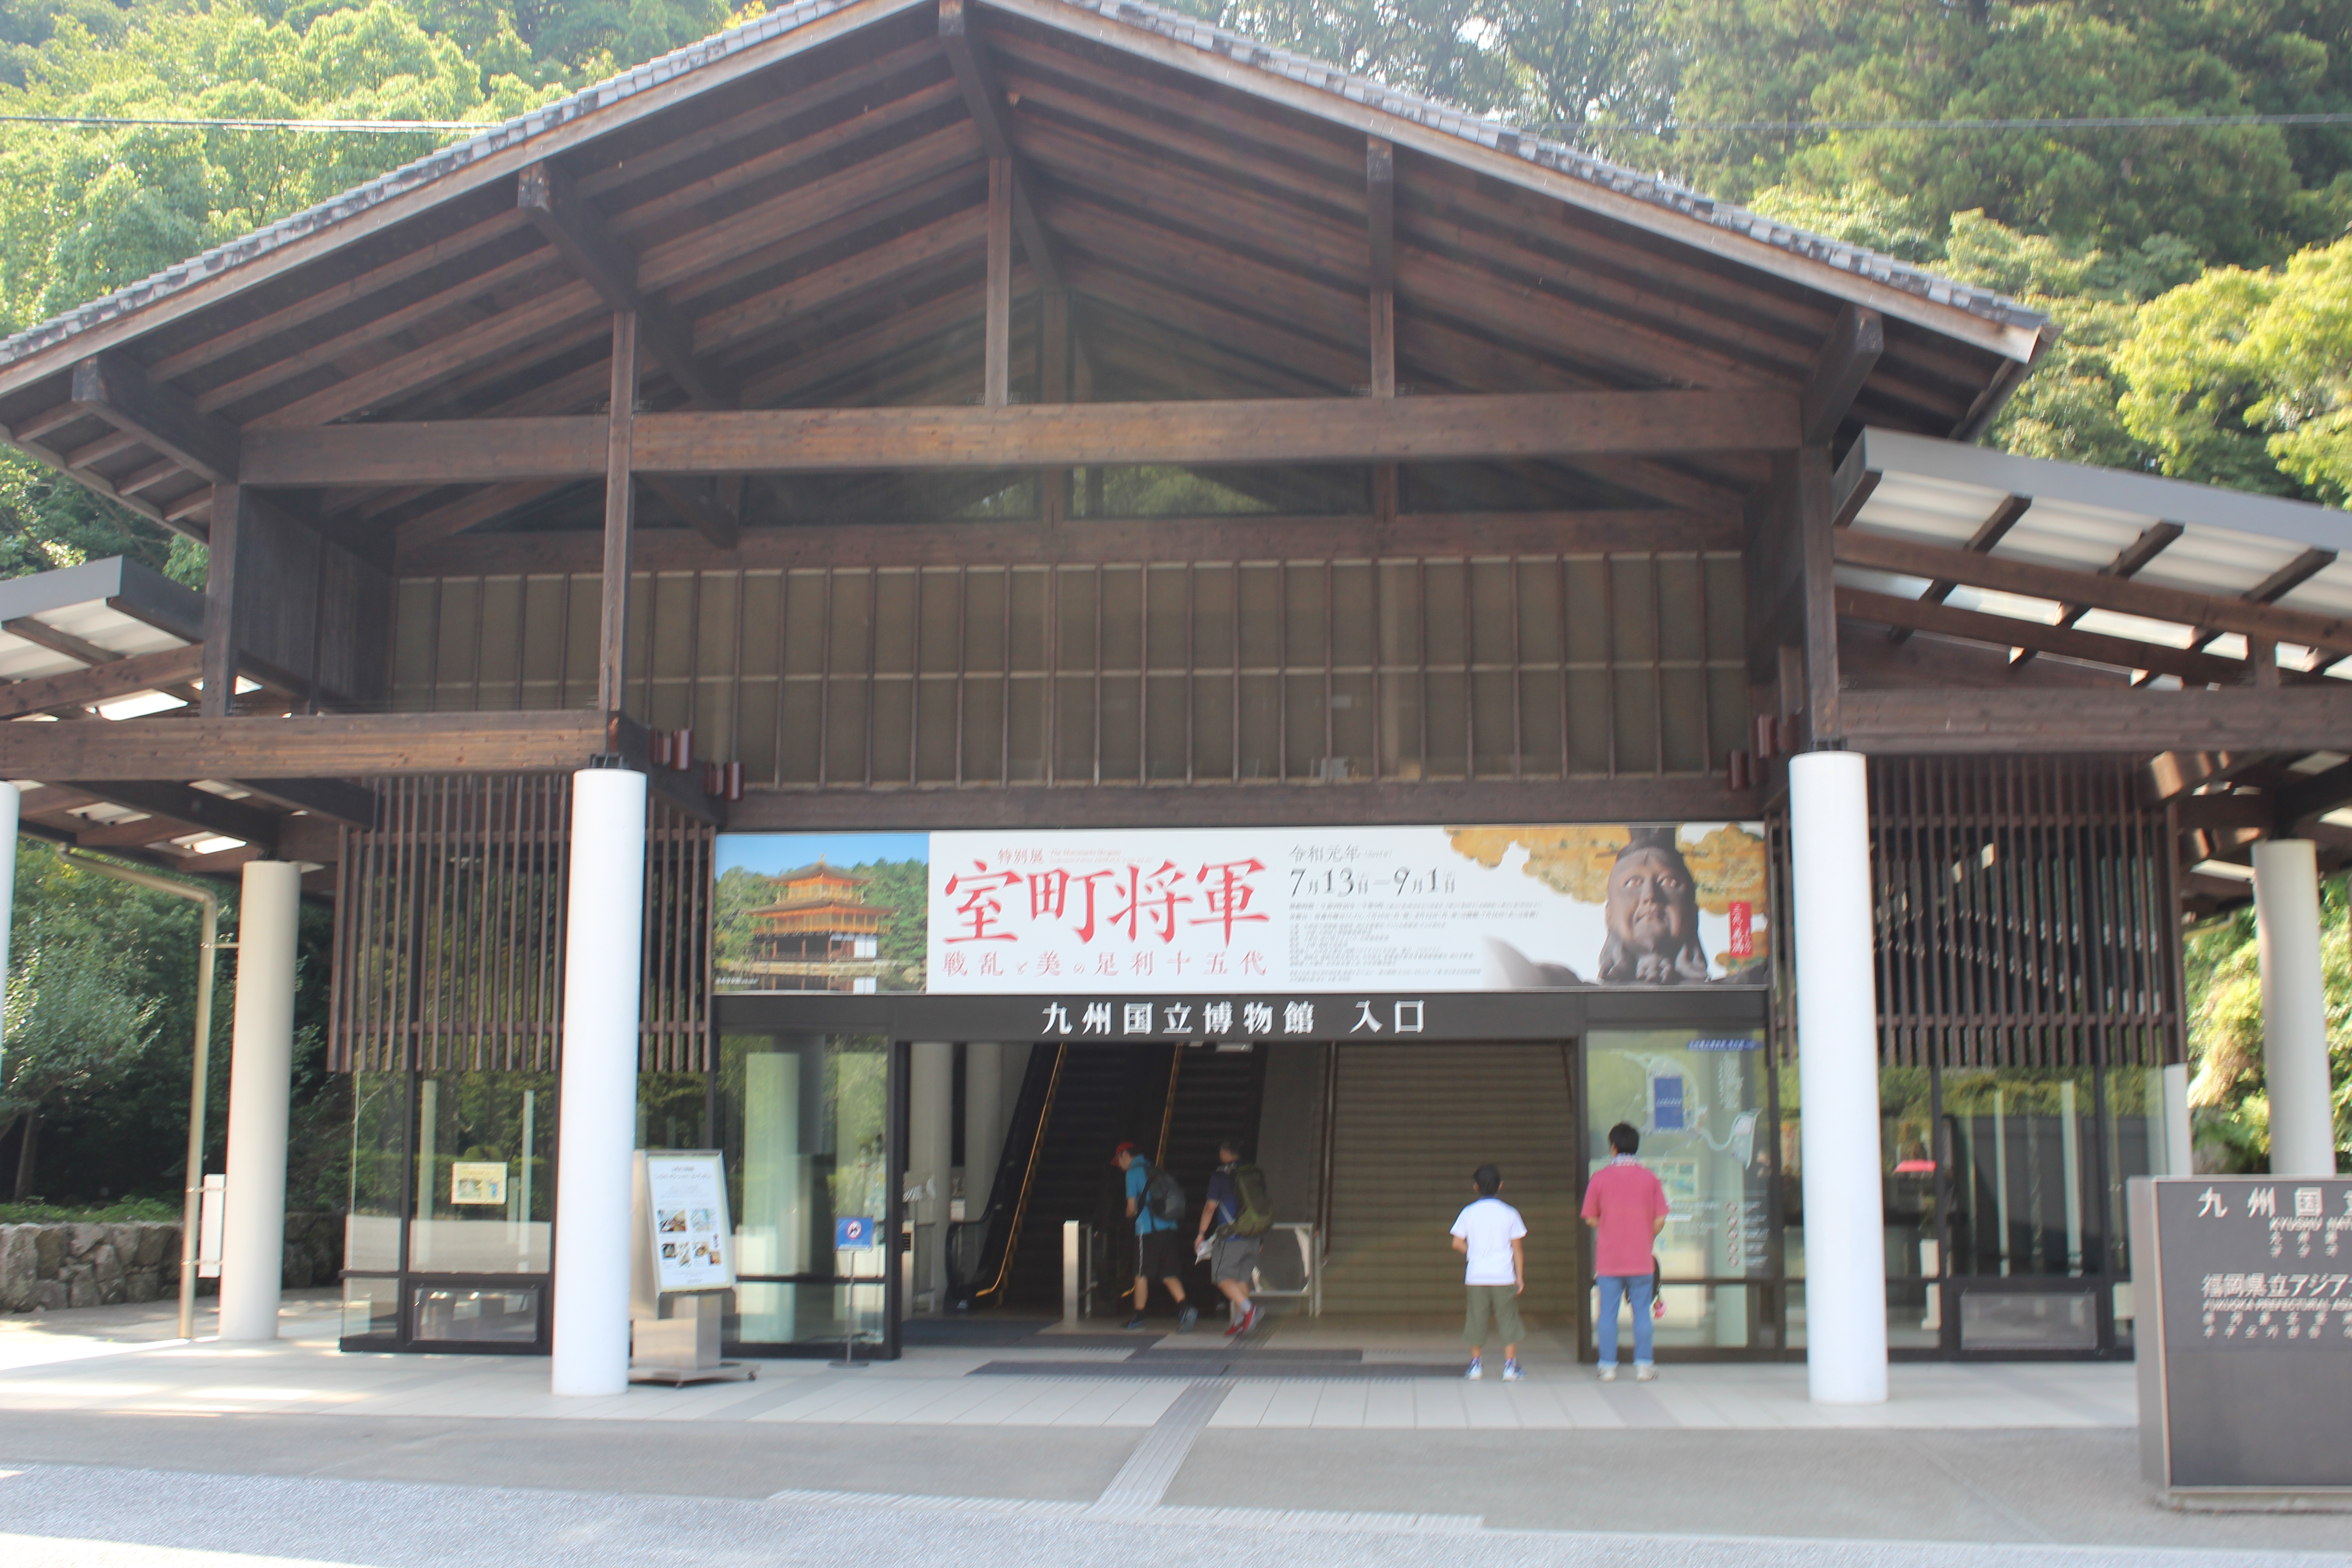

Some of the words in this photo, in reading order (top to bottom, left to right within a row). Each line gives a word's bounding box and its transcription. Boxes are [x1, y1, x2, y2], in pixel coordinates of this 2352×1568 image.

[997, 848, 1044, 865] 特別展
[942, 858, 1270, 948] 室町将軍
[1041, 1001, 1314, 1035] 九州国立博物館
[1349, 1000, 1425, 1034] 入口
[2201, 1273, 2352, 1298] 福岡県立アジア
